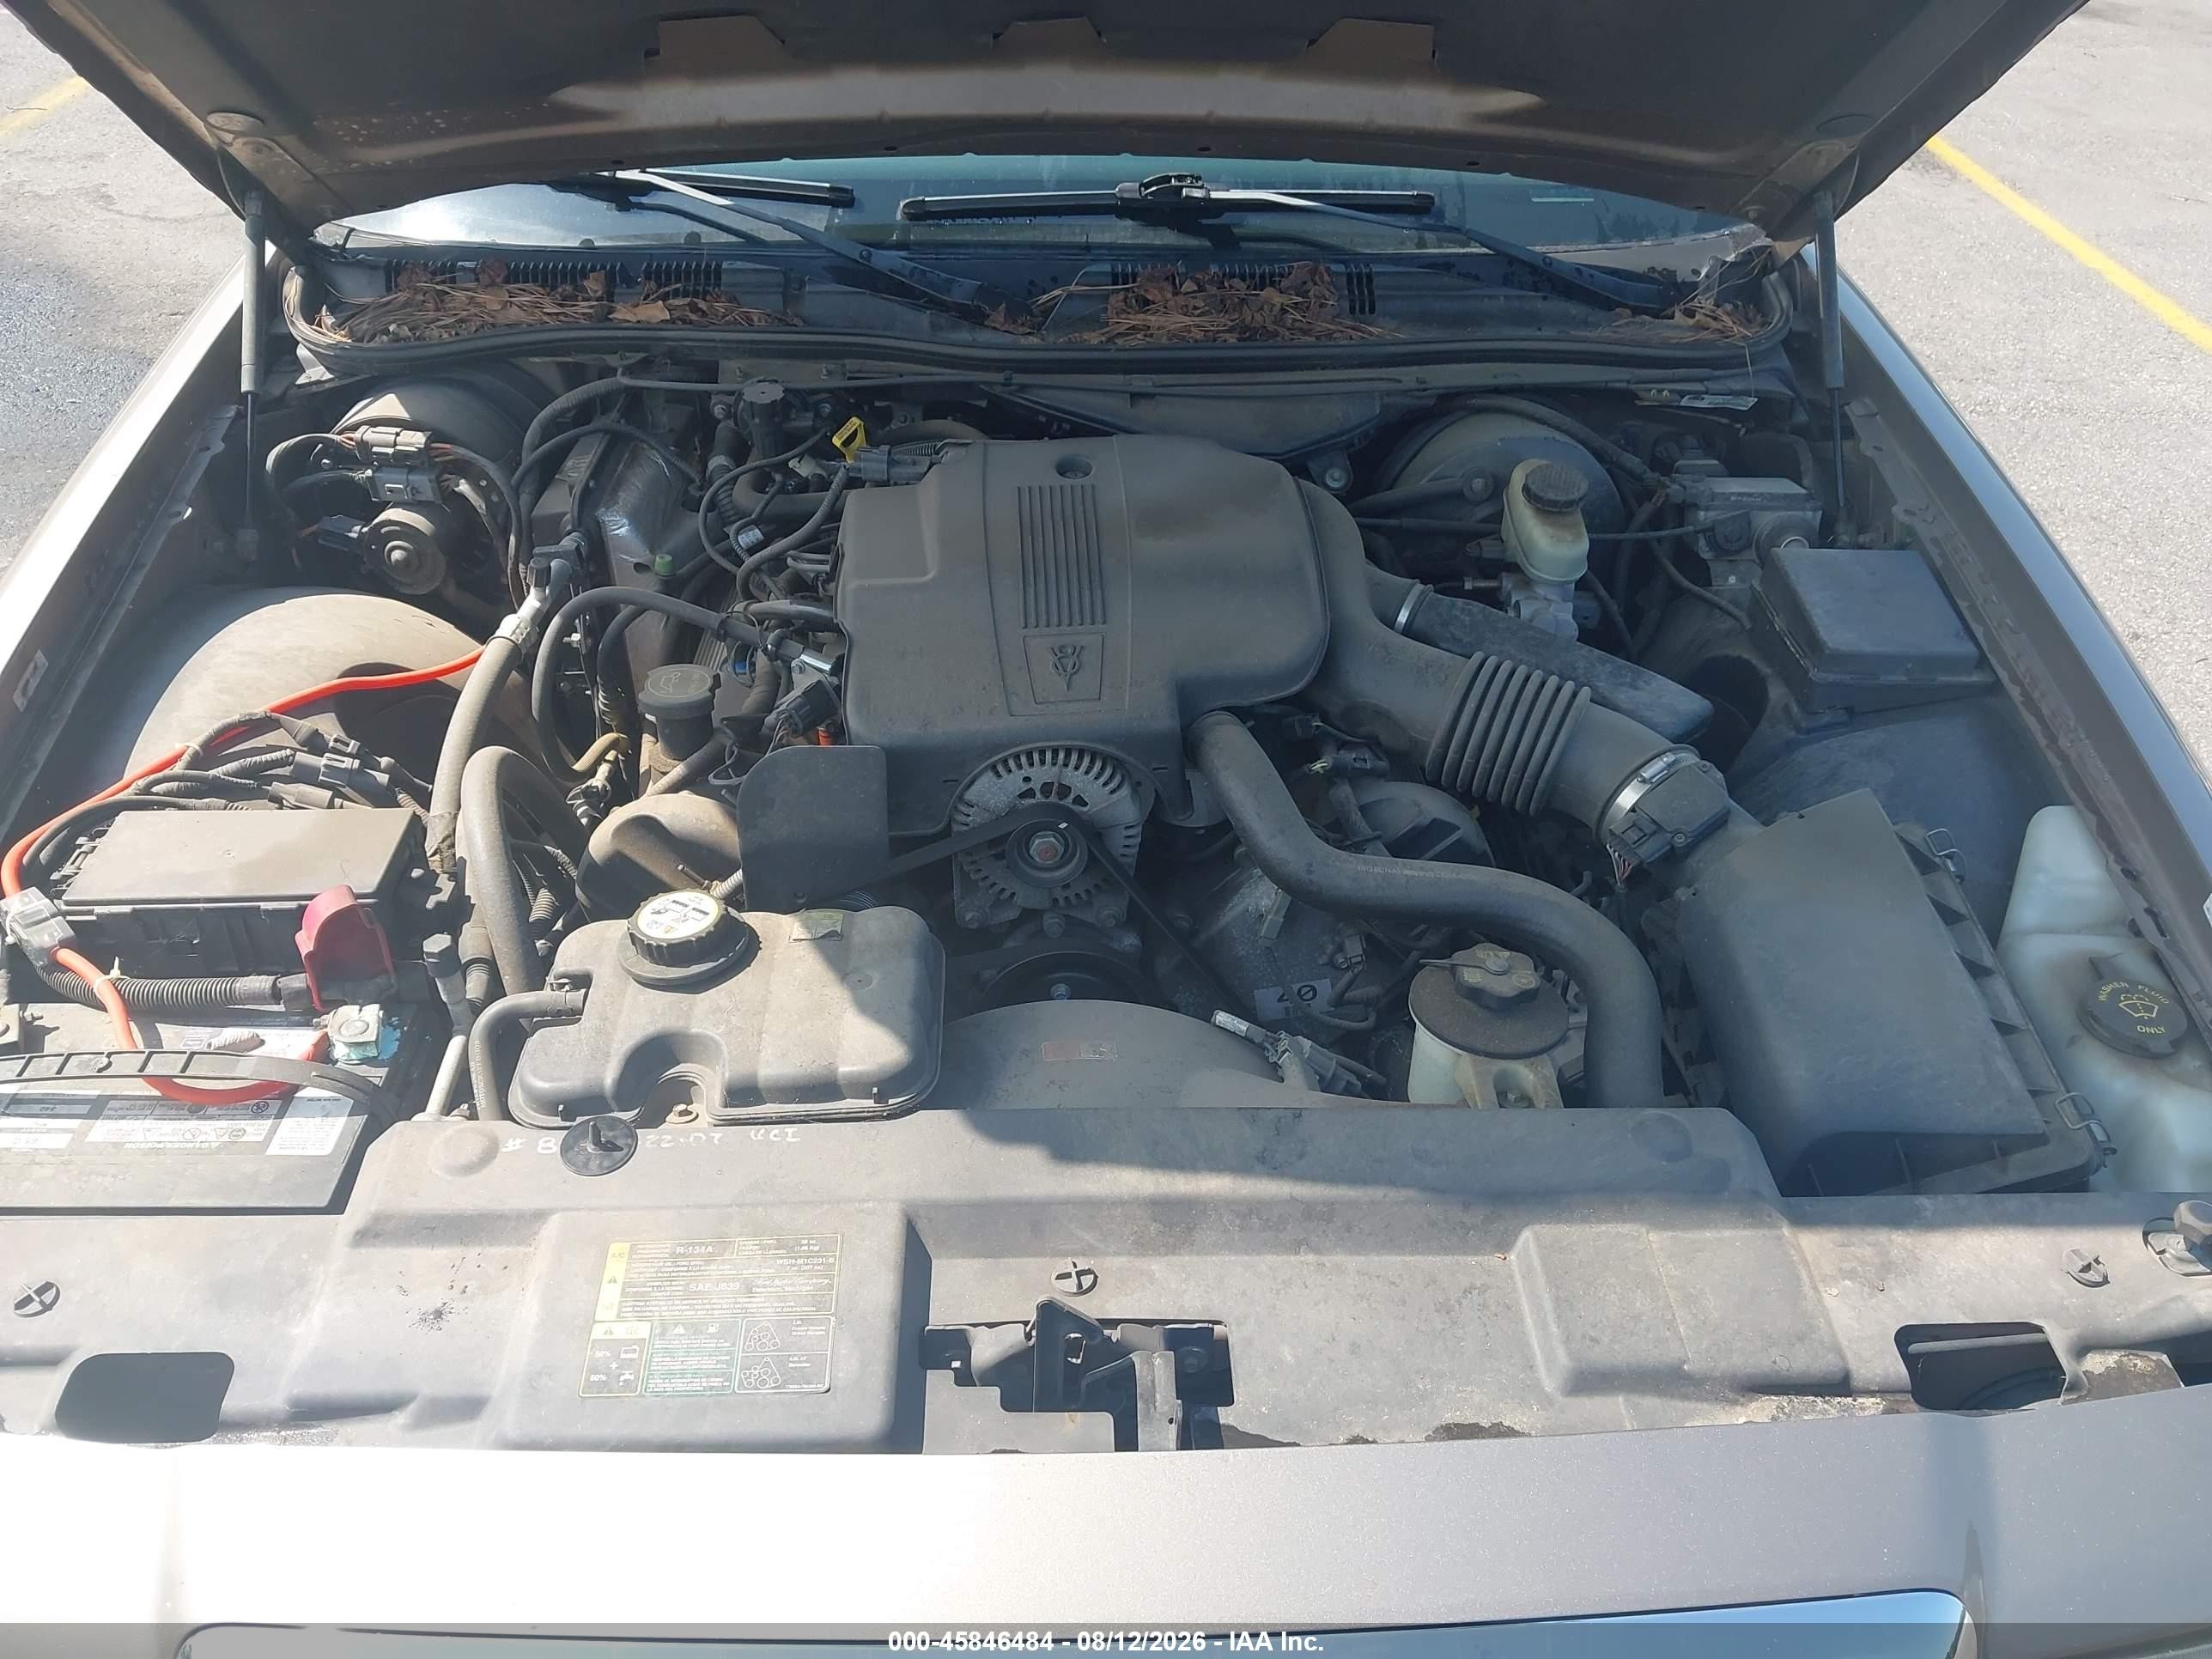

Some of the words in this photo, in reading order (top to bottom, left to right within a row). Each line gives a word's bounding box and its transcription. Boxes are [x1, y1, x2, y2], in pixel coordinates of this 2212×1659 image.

[2098, 981, 2130, 1002] WASHER
[2137, 985, 2170, 1004] FLUID
[2136, 1025, 2166, 1034] ONLY
[675, 1244, 714, 1255] R-134A
[689, 1283, 712, 1292] SAE
